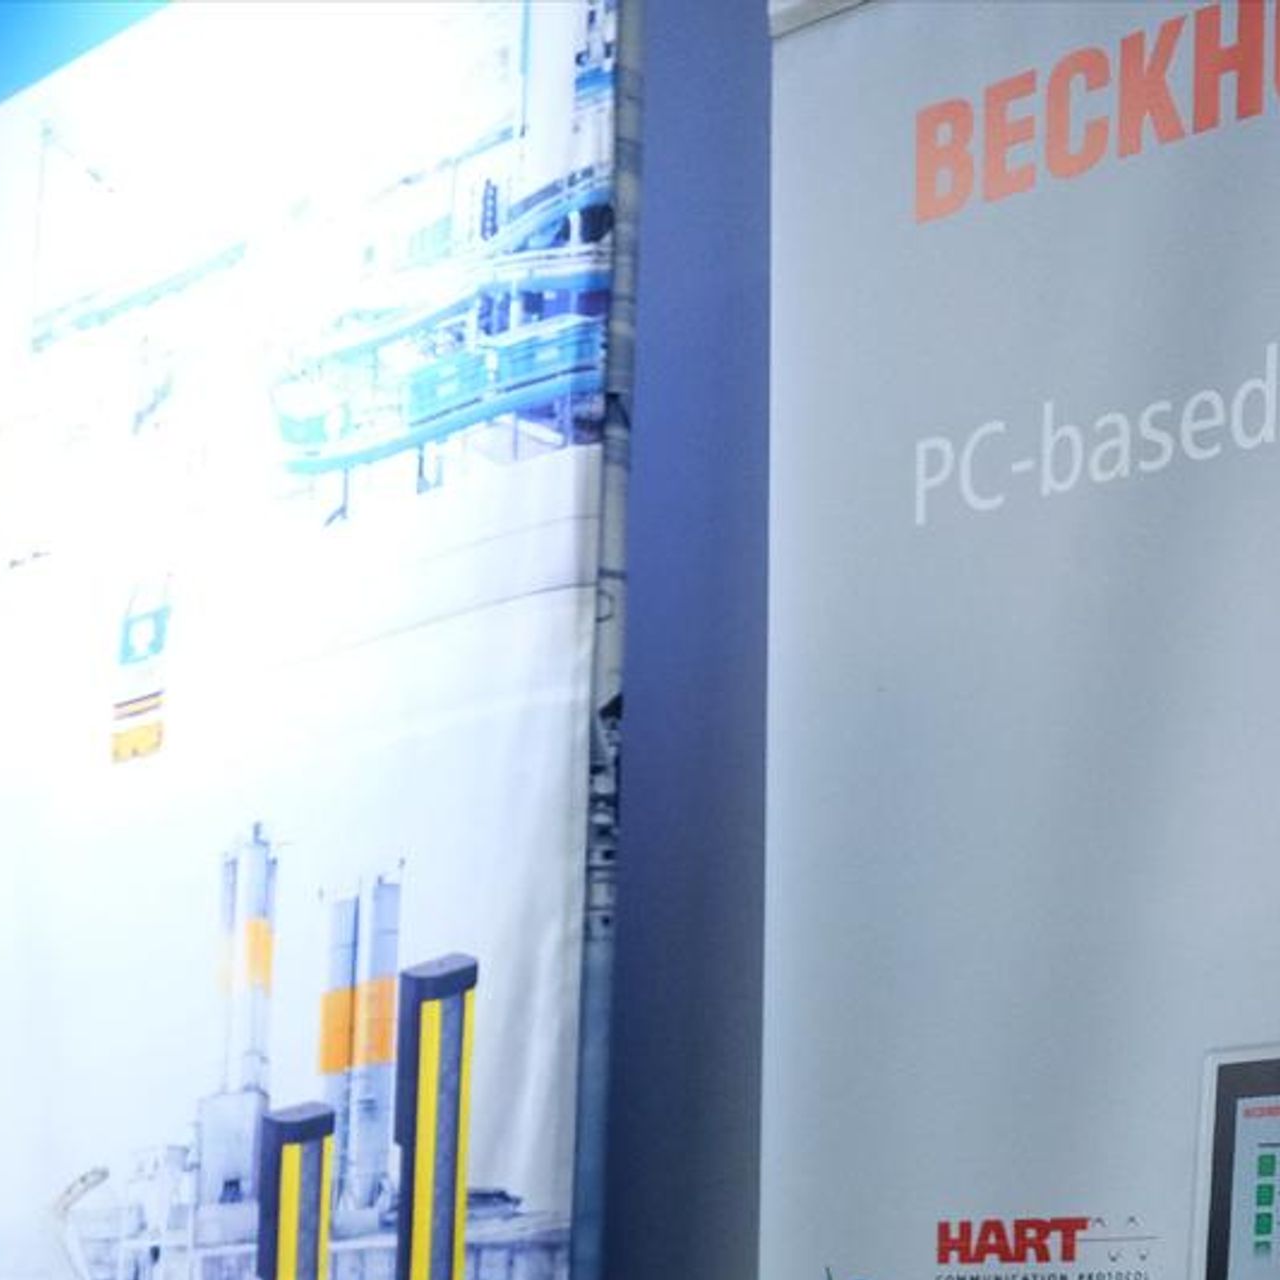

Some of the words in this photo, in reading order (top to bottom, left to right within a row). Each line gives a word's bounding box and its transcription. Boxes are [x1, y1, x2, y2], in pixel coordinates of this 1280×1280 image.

[915, 0, 1280, 225] BECKH
[914, 343, 1278, 525] PC-based
[936, 1217, 1090, 1265] HART
